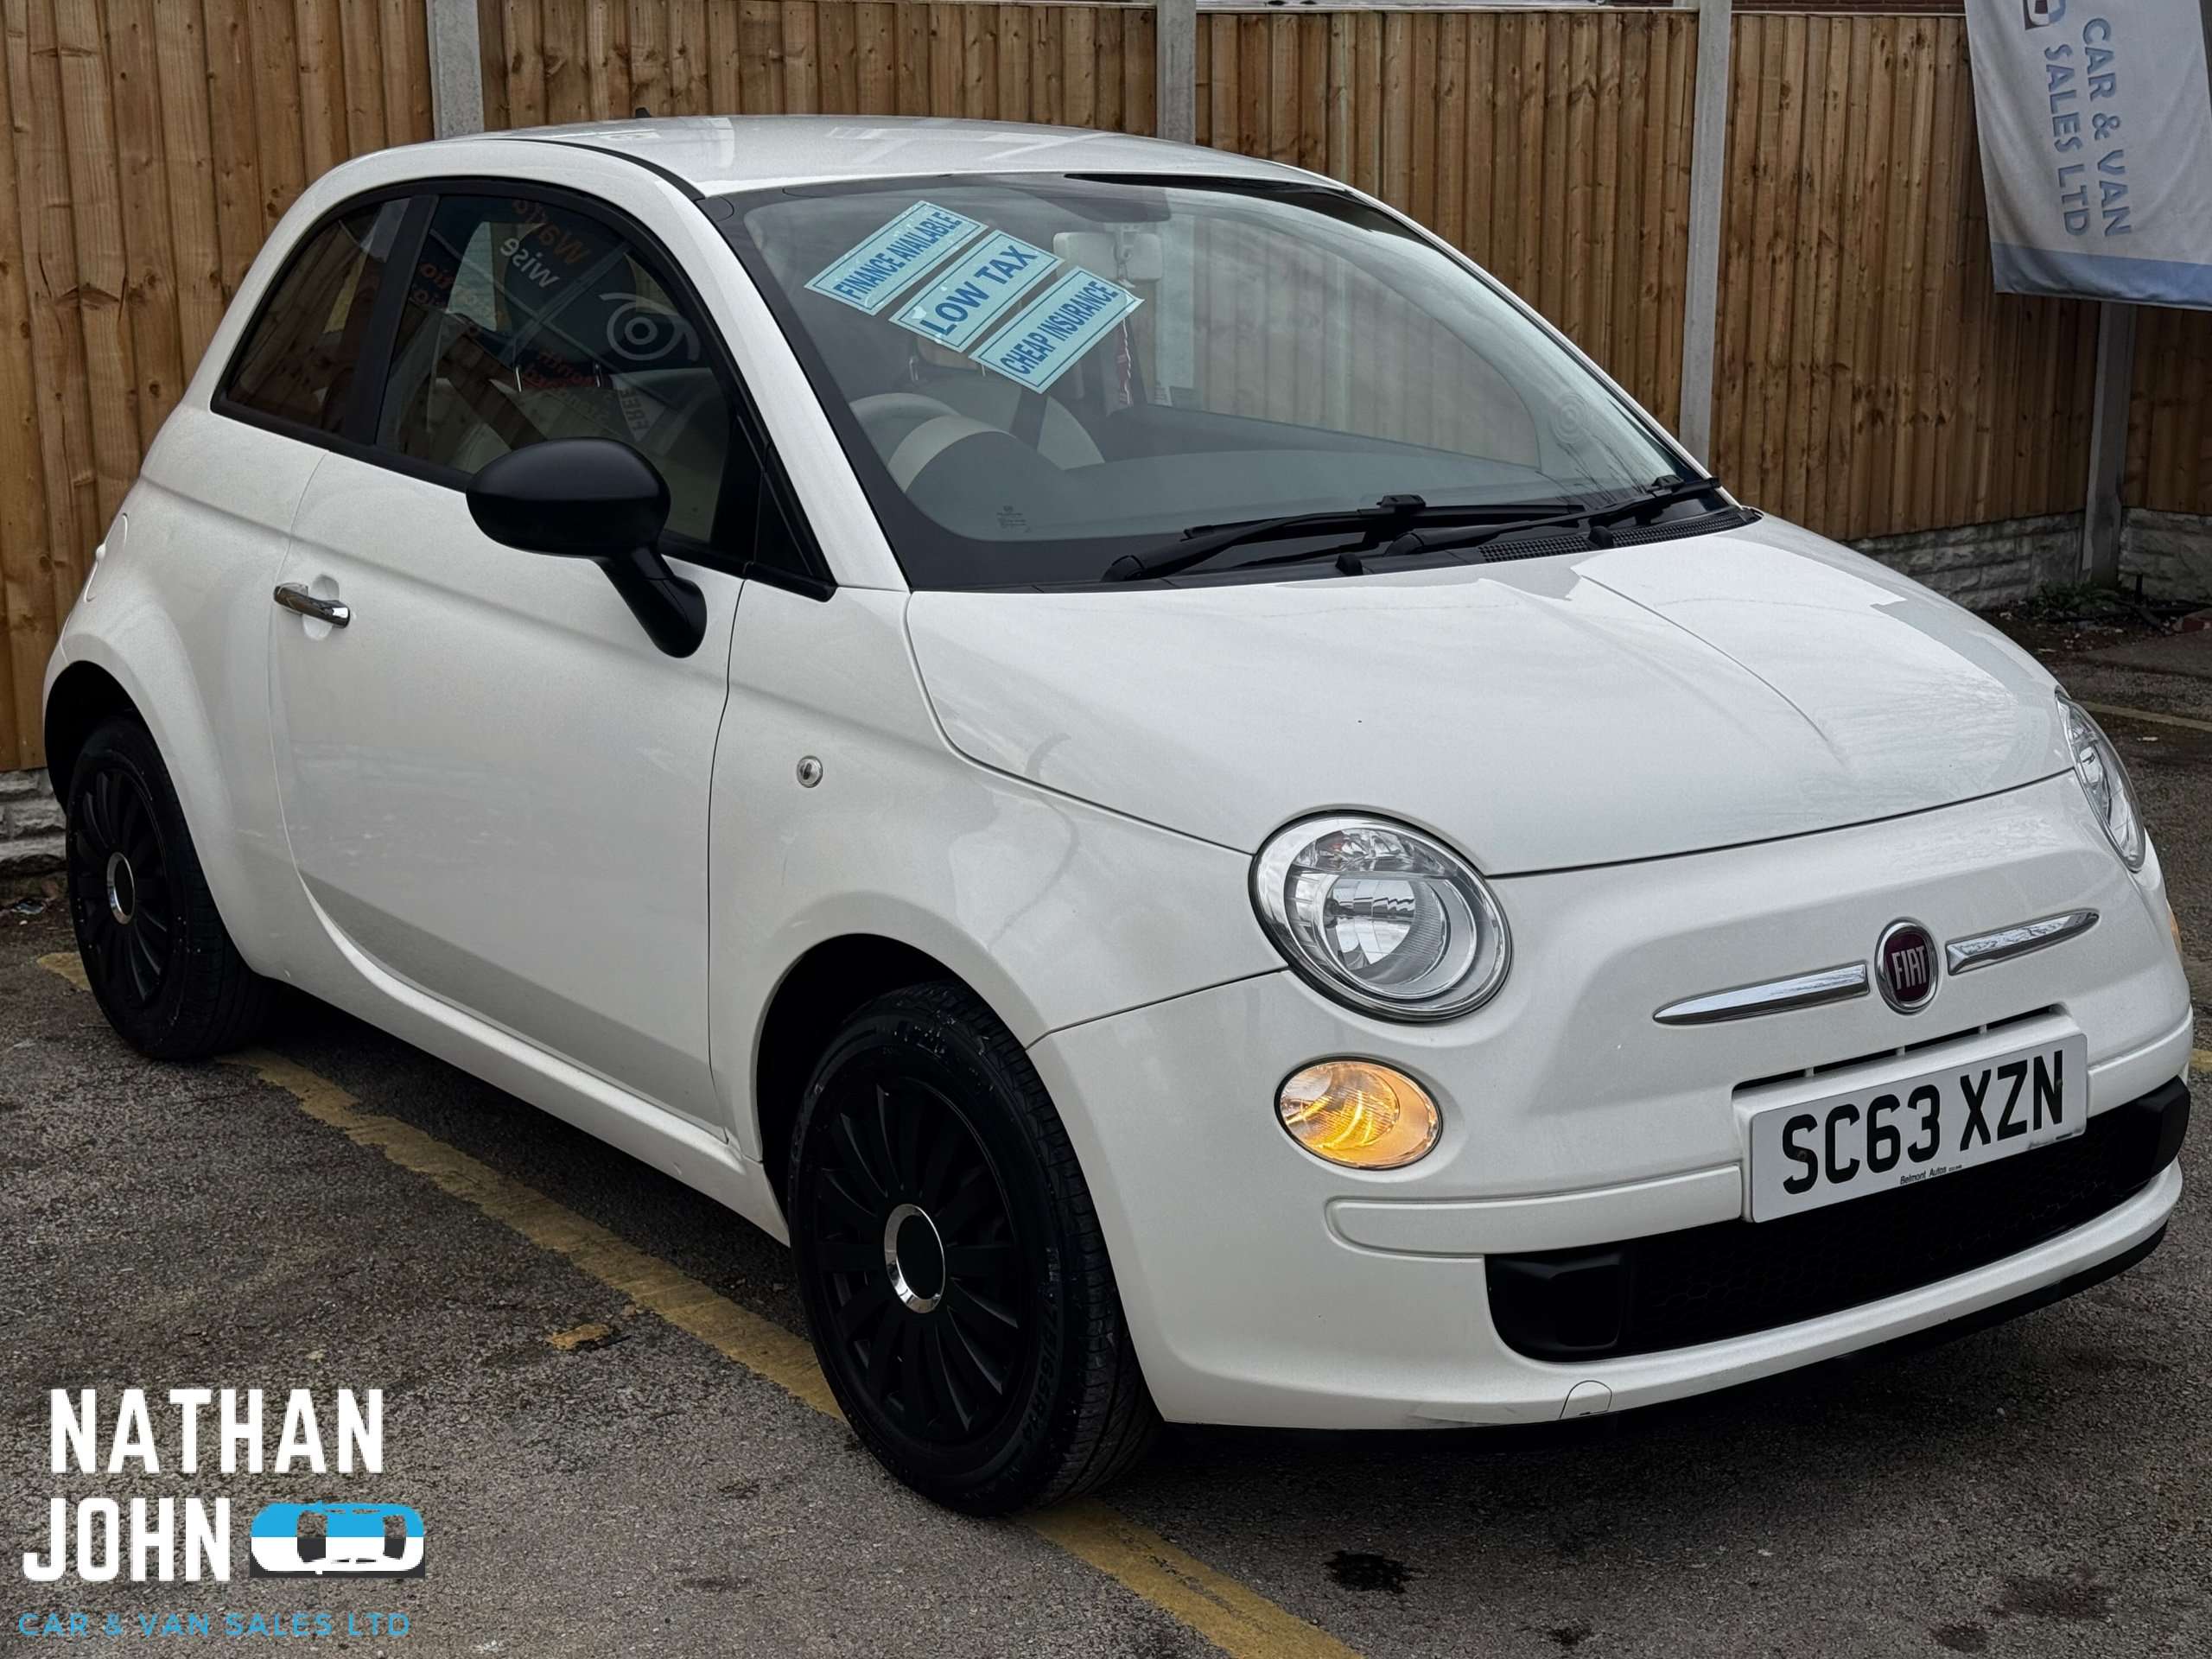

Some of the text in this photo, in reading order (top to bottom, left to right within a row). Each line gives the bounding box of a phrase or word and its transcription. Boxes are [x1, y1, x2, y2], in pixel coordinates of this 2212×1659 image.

[2044, 43, 2090, 237] SALES LTD
[2082, 17, 2132, 238] CAR & VAN
[833, 211, 963, 301] FINANCE AVAILABLE
[919, 245, 1039, 337] LOW TAX
[1000, 280, 1122, 375] CHEAP INSURANCE
[1891, 944, 1928, 990] FIAT
[1782, 1050, 2064, 1195] SC63 XZN
[1900, 1170, 1927, 1185] Belmont
[1929, 1165, 1948, 1178] Autos
